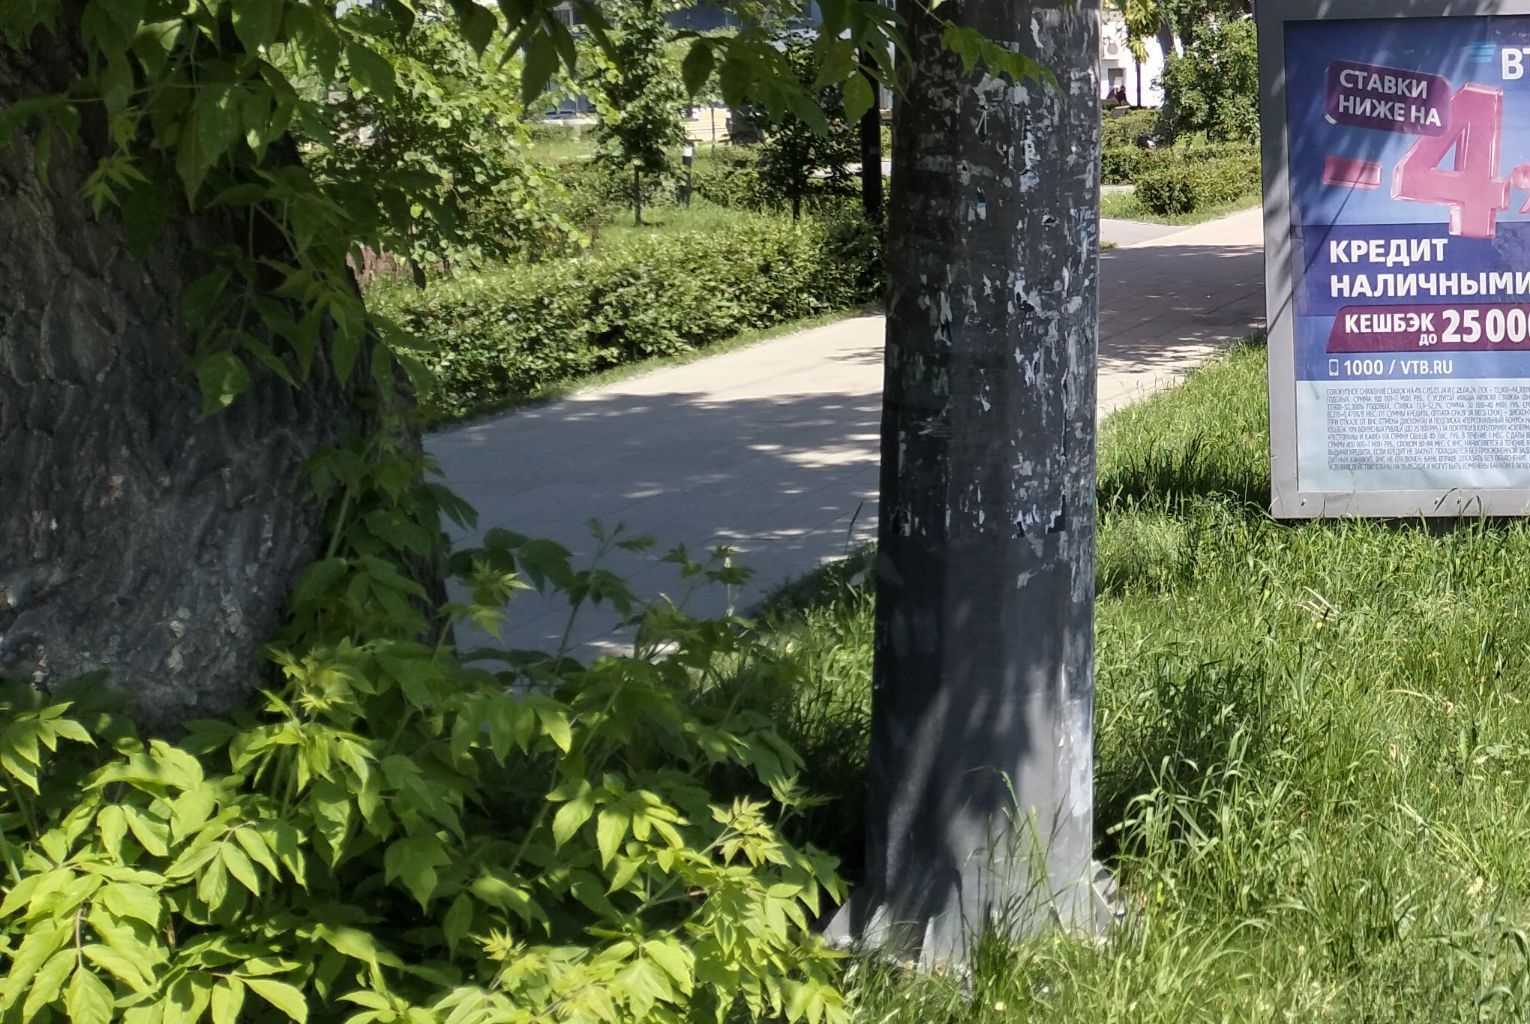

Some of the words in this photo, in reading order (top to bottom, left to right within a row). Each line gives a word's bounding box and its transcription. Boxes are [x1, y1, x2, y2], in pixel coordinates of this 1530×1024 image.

[1340, 69, 1428, 99] СТАВКИ
[1339, 94, 1406, 122] НИЖЕ
[1410, 106, 1442, 127] НА
[1329, 238, 1448, 267] КРЕДИТ
[1344, 312, 1436, 334] КЕШБЭК
[1344, 360, 1384, 375] 1000
[1400, 360, 1453, 375] VTB.RU
